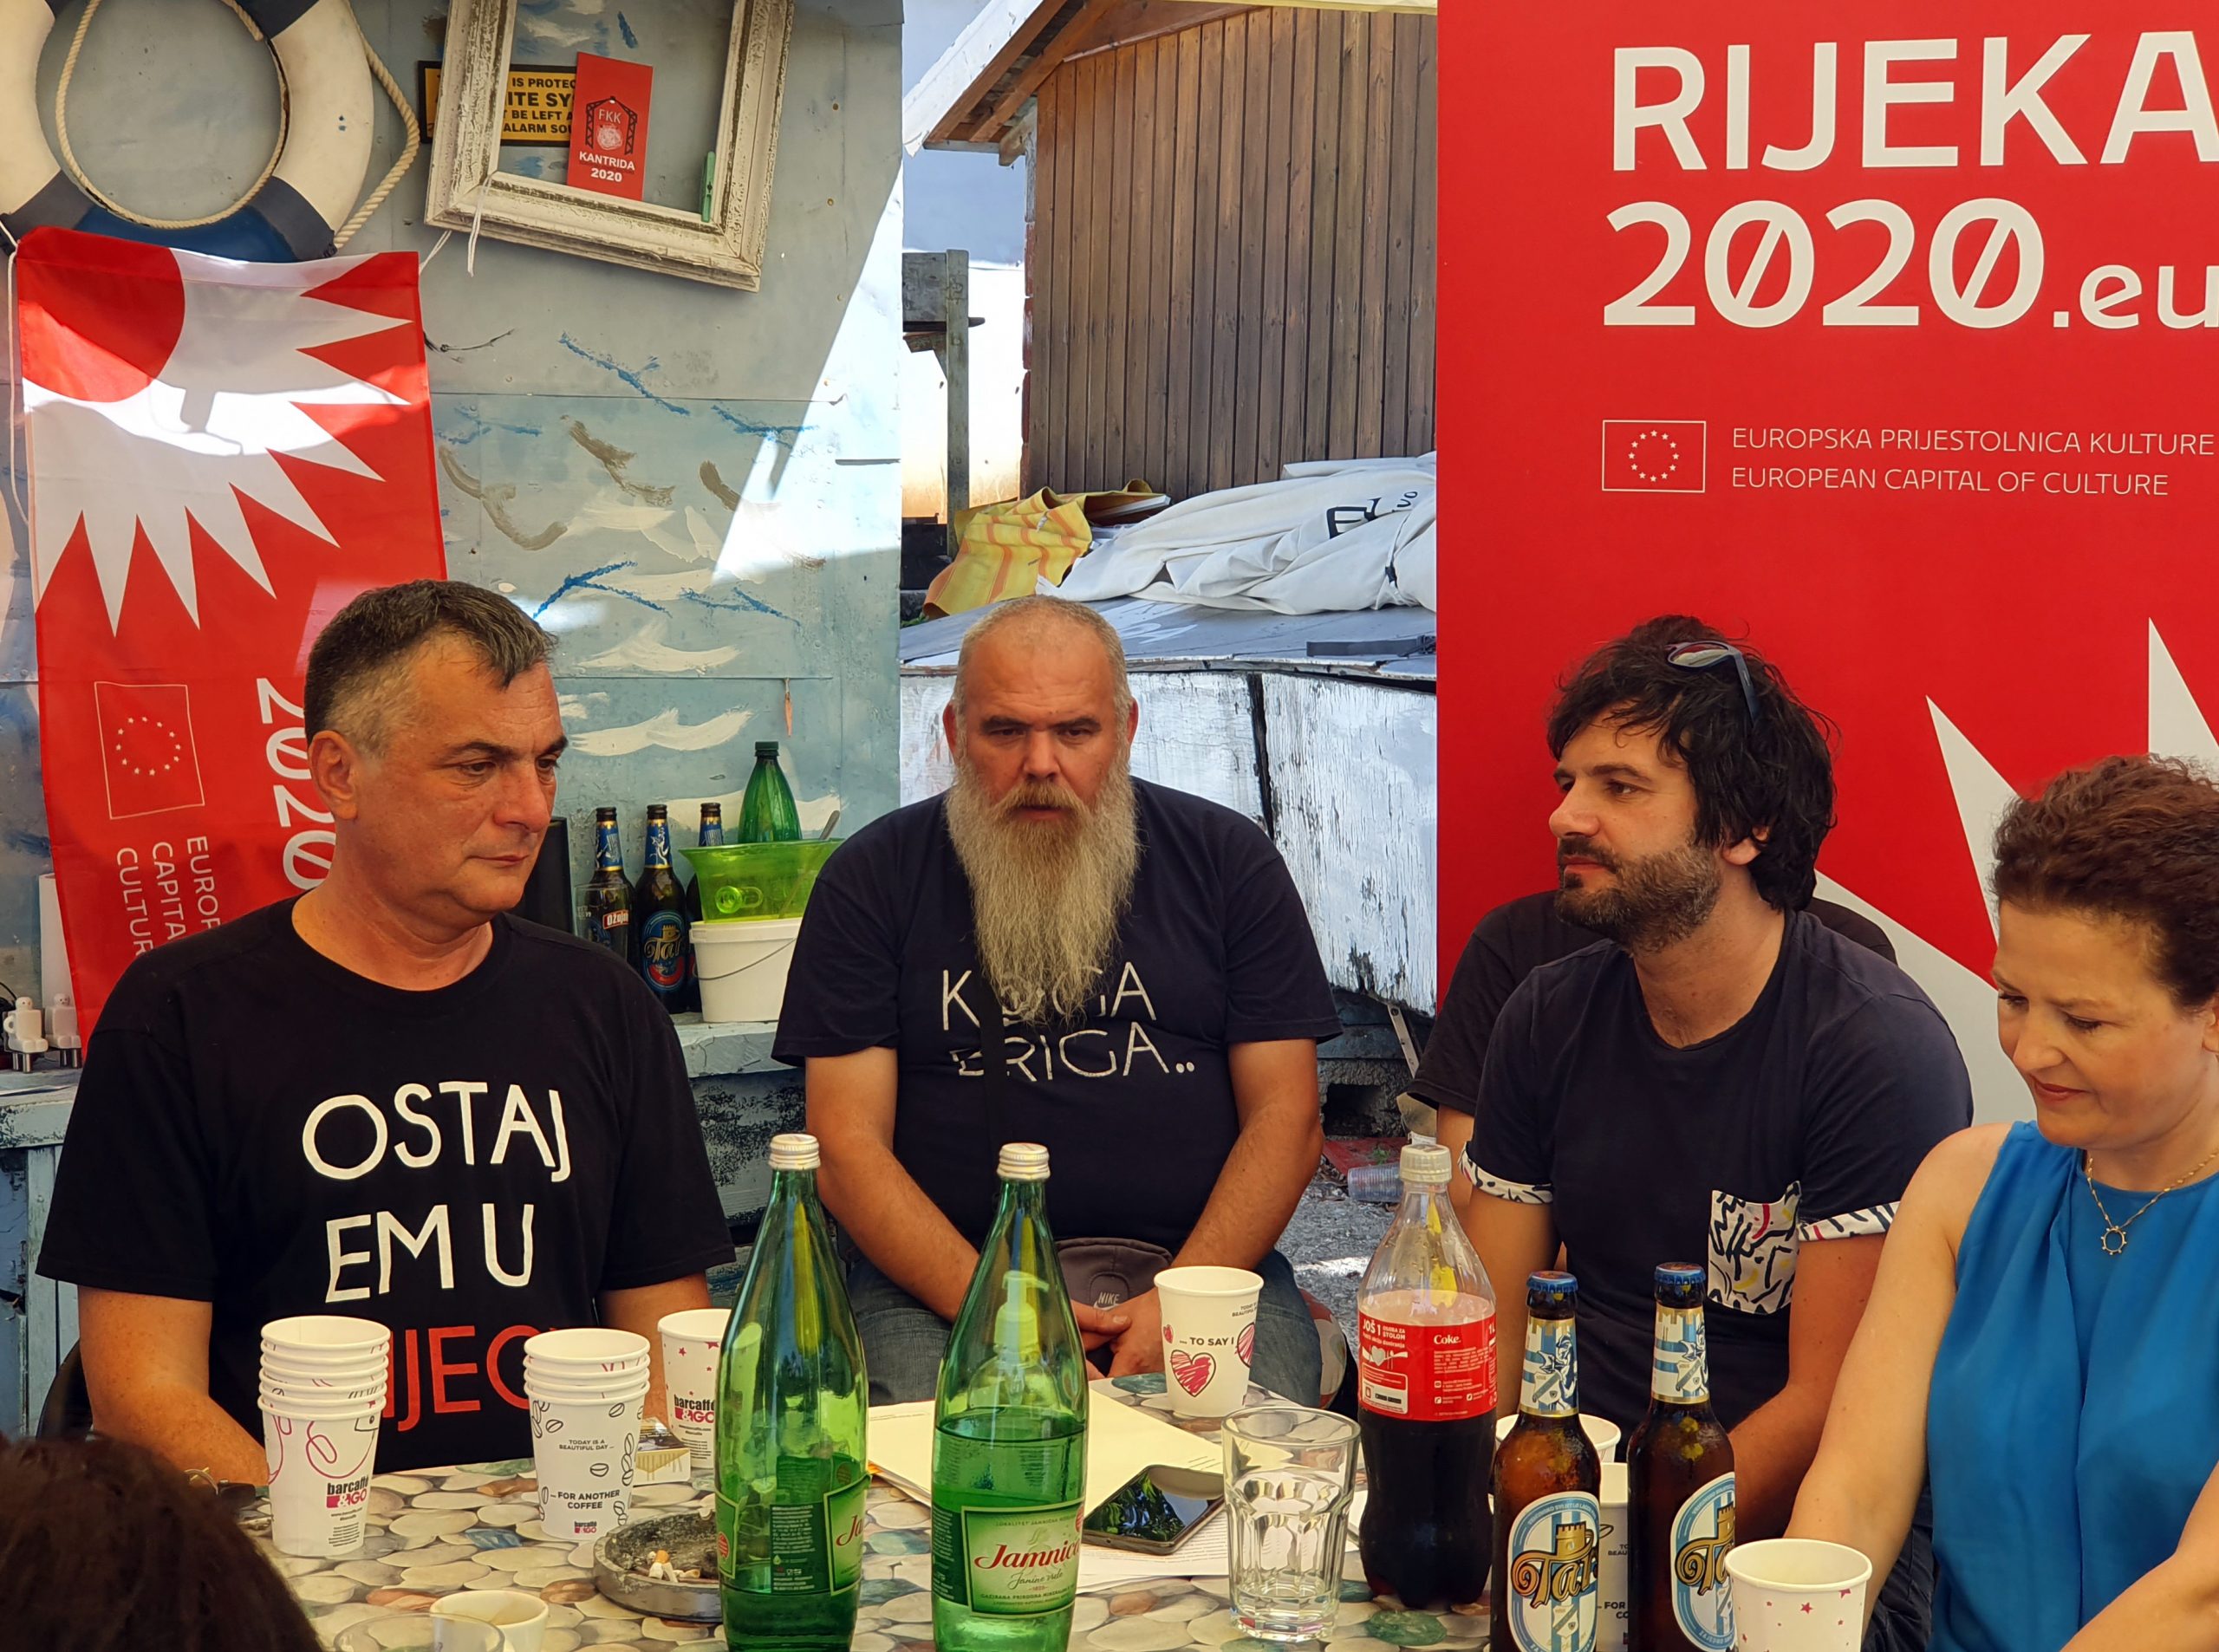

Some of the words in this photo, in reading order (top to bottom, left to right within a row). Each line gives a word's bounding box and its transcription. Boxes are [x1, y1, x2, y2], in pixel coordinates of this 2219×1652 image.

[512, 78, 524, 87] IS
[528, 79, 576, 88] PROTEC
[505, 92, 539, 107] ITE
[546, 93, 575, 107] SY
[1613, 30, 2219, 172] RIJEKA
[511, 110, 528, 120] BE
[532, 111, 563, 120] LEFT
[598, 108, 621, 123] FKK
[504, 123, 547, 133] ALARM
[550, 125, 572, 133] SO
[579, 151, 635, 171] KANTRIDA
[590, 167, 623, 182] 2020
[1603, 198, 2219, 328] 2020.eu
[1732, 428, 1873, 451] EUROPSKA
[1879, 430, 2082, 455] PRIJESTOLNICA
[2089, 433, 2216, 457] KULTURE
[1732, 468, 1877, 490] EUROPEAN
[1884, 469, 1991, 492] CAPITAL
[1997, 472, 2036, 492] OF
[2042, 472, 2170, 496] CULTURE
[152, 842, 186, 940] CAPITA
[186, 836, 221, 929] EUROP
[116, 847, 154, 956] CULTUR
[302, 1080, 571, 1182] OSTAJ
[1097, 1291, 1120, 1304] NIKE
[1207, 1337, 1229, 1346] SAY
[1231, 1337, 1234, 1345] I
[1433, 1334, 1461, 1345] Coke
[381, 1324, 562, 1432] IJEC
[578, 1489, 620, 1500] ANOTHER
[836, 1514, 863, 1546] Ja
[1604, 1601, 1626, 1610] FOR
